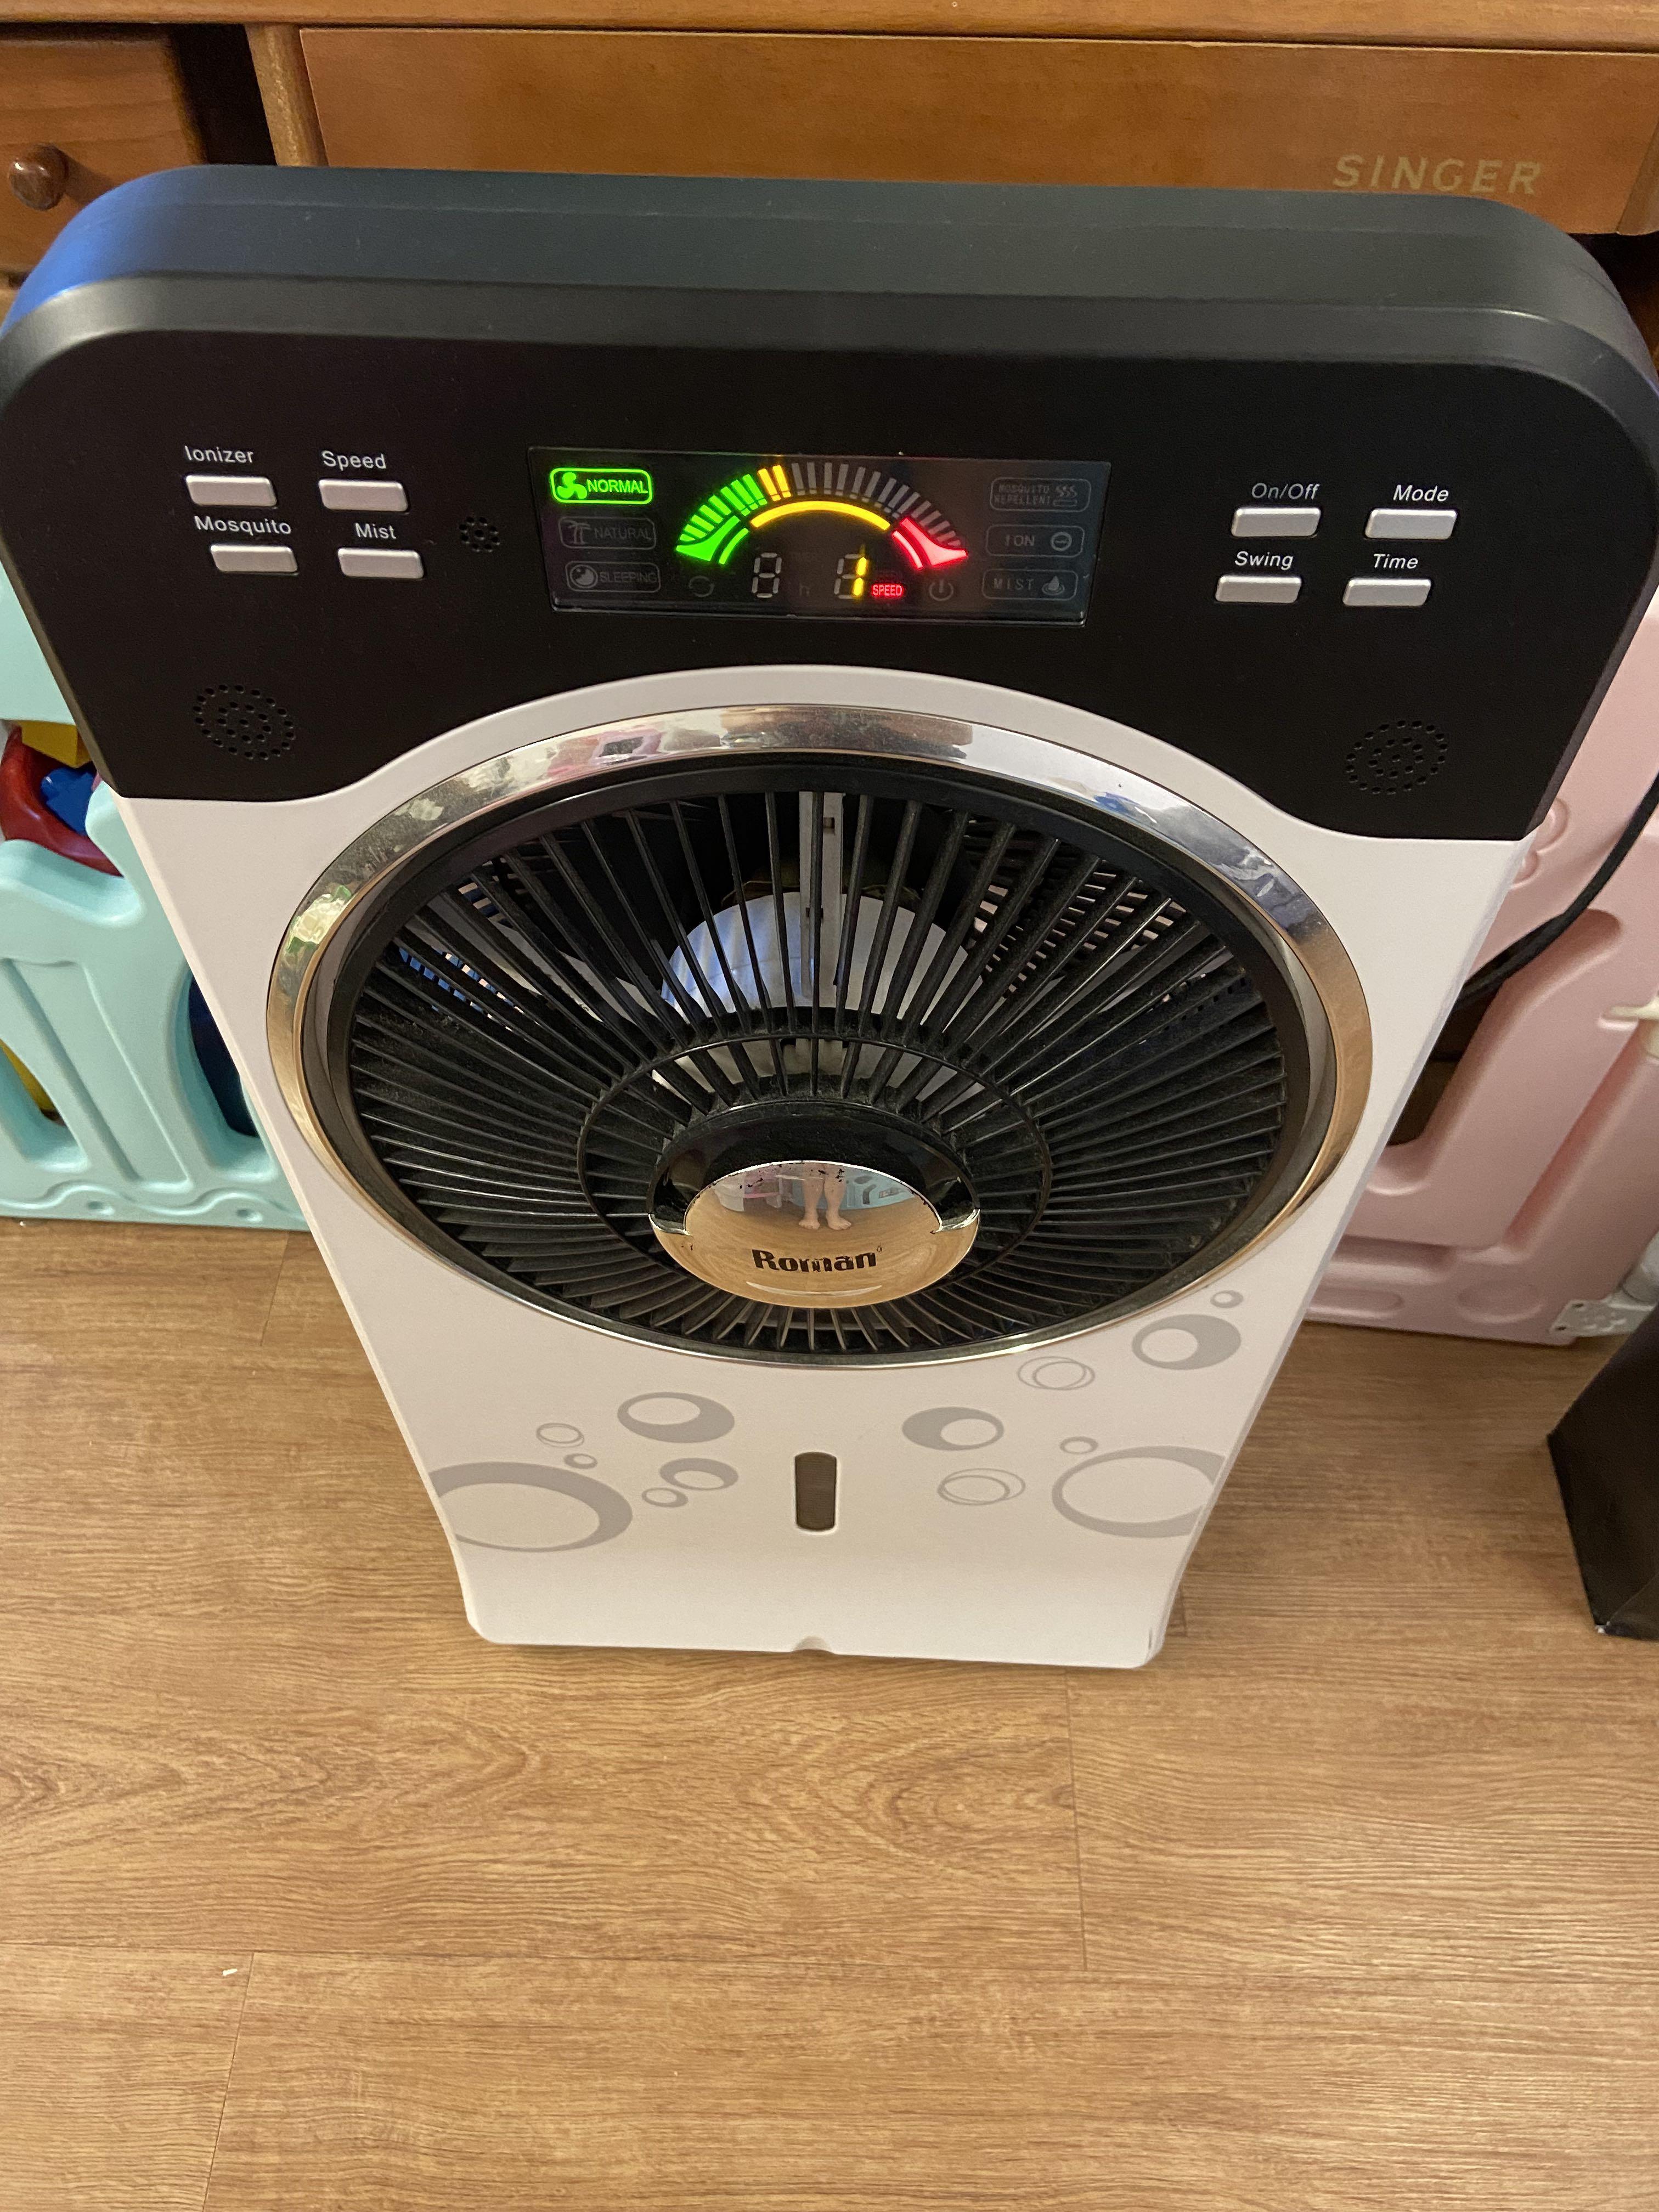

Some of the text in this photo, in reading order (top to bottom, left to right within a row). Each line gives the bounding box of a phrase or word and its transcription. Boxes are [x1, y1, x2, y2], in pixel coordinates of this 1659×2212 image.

[1333, 154, 1542, 194] SINGER
[184, 445, 253, 464] Ionizer
[321, 450, 387, 470] Speed
[586, 479, 648, 494] NORMAL
[1251, 483, 1321, 500] On/Off
[1392, 484, 1449, 502] Mode
[194, 515, 292, 536] Mosquito
[354, 522, 397, 540] Mist
[594, 527, 653, 541] NATURAL
[1005, 535, 1035, 546] ION
[1234, 551, 1294, 571] Swing
[1373, 554, 1419, 569] Time
[600, 572, 657, 583] SLEEPING
[994, 578, 1034, 591] MIST
[872, 585, 903, 597] SPEED
[752, 1249, 877, 1273] Roman
